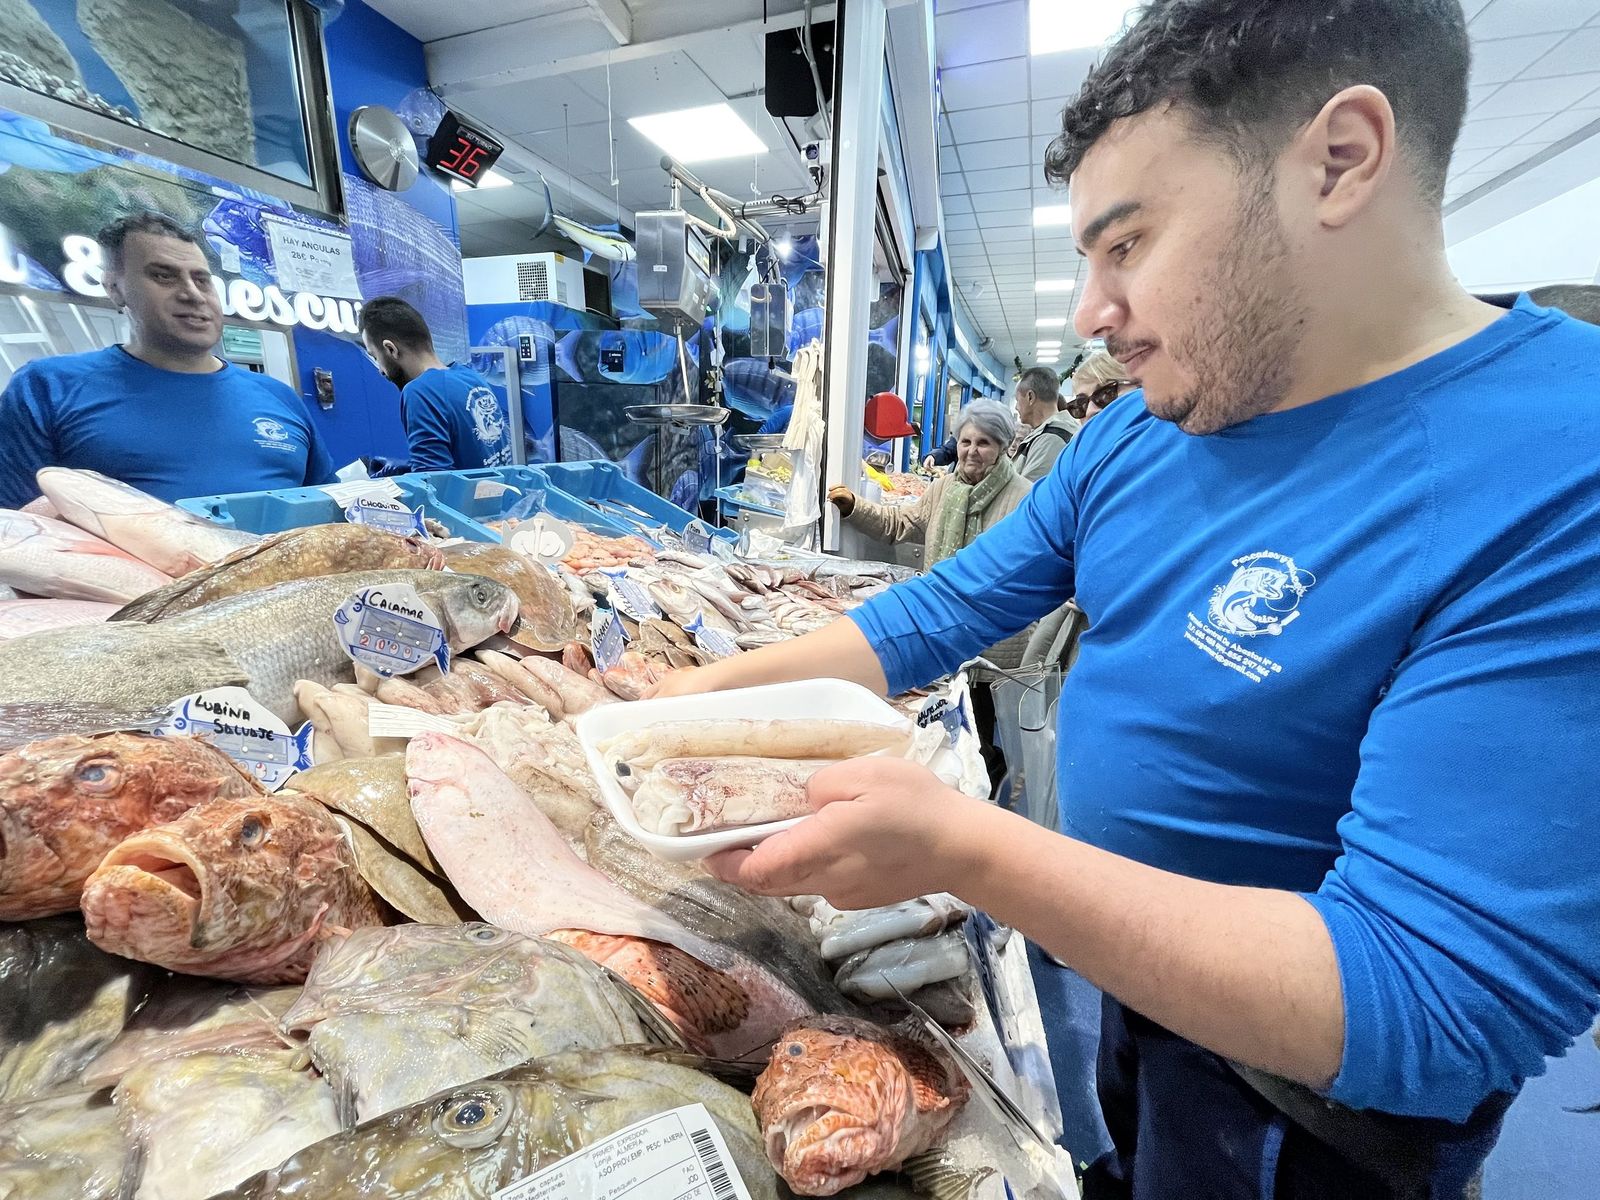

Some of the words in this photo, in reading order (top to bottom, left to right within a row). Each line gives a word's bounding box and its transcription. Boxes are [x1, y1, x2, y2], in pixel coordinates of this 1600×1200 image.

[440, 137, 488, 177] 36
[283, 235, 300, 247] HAY
[301, 240, 341, 256] ANGULAS
[63, 235, 106, 297] &
[360, 498, 401, 511] CHOQUITO
[368, 591, 424, 621] CALAMAR
[1202, 624, 1224, 642] Central
[1230, 642, 1264, 663] Abastos
[195, 694, 251, 721] LUBINA
[592, 1144, 615, 1160] PRIMER
[616, 1127, 649, 1148] EXPEDIDOR
[594, 1154, 612, 1169] Lonja
[527, 1186, 537, 1195] de
[540, 1172, 564, 1189] captura
